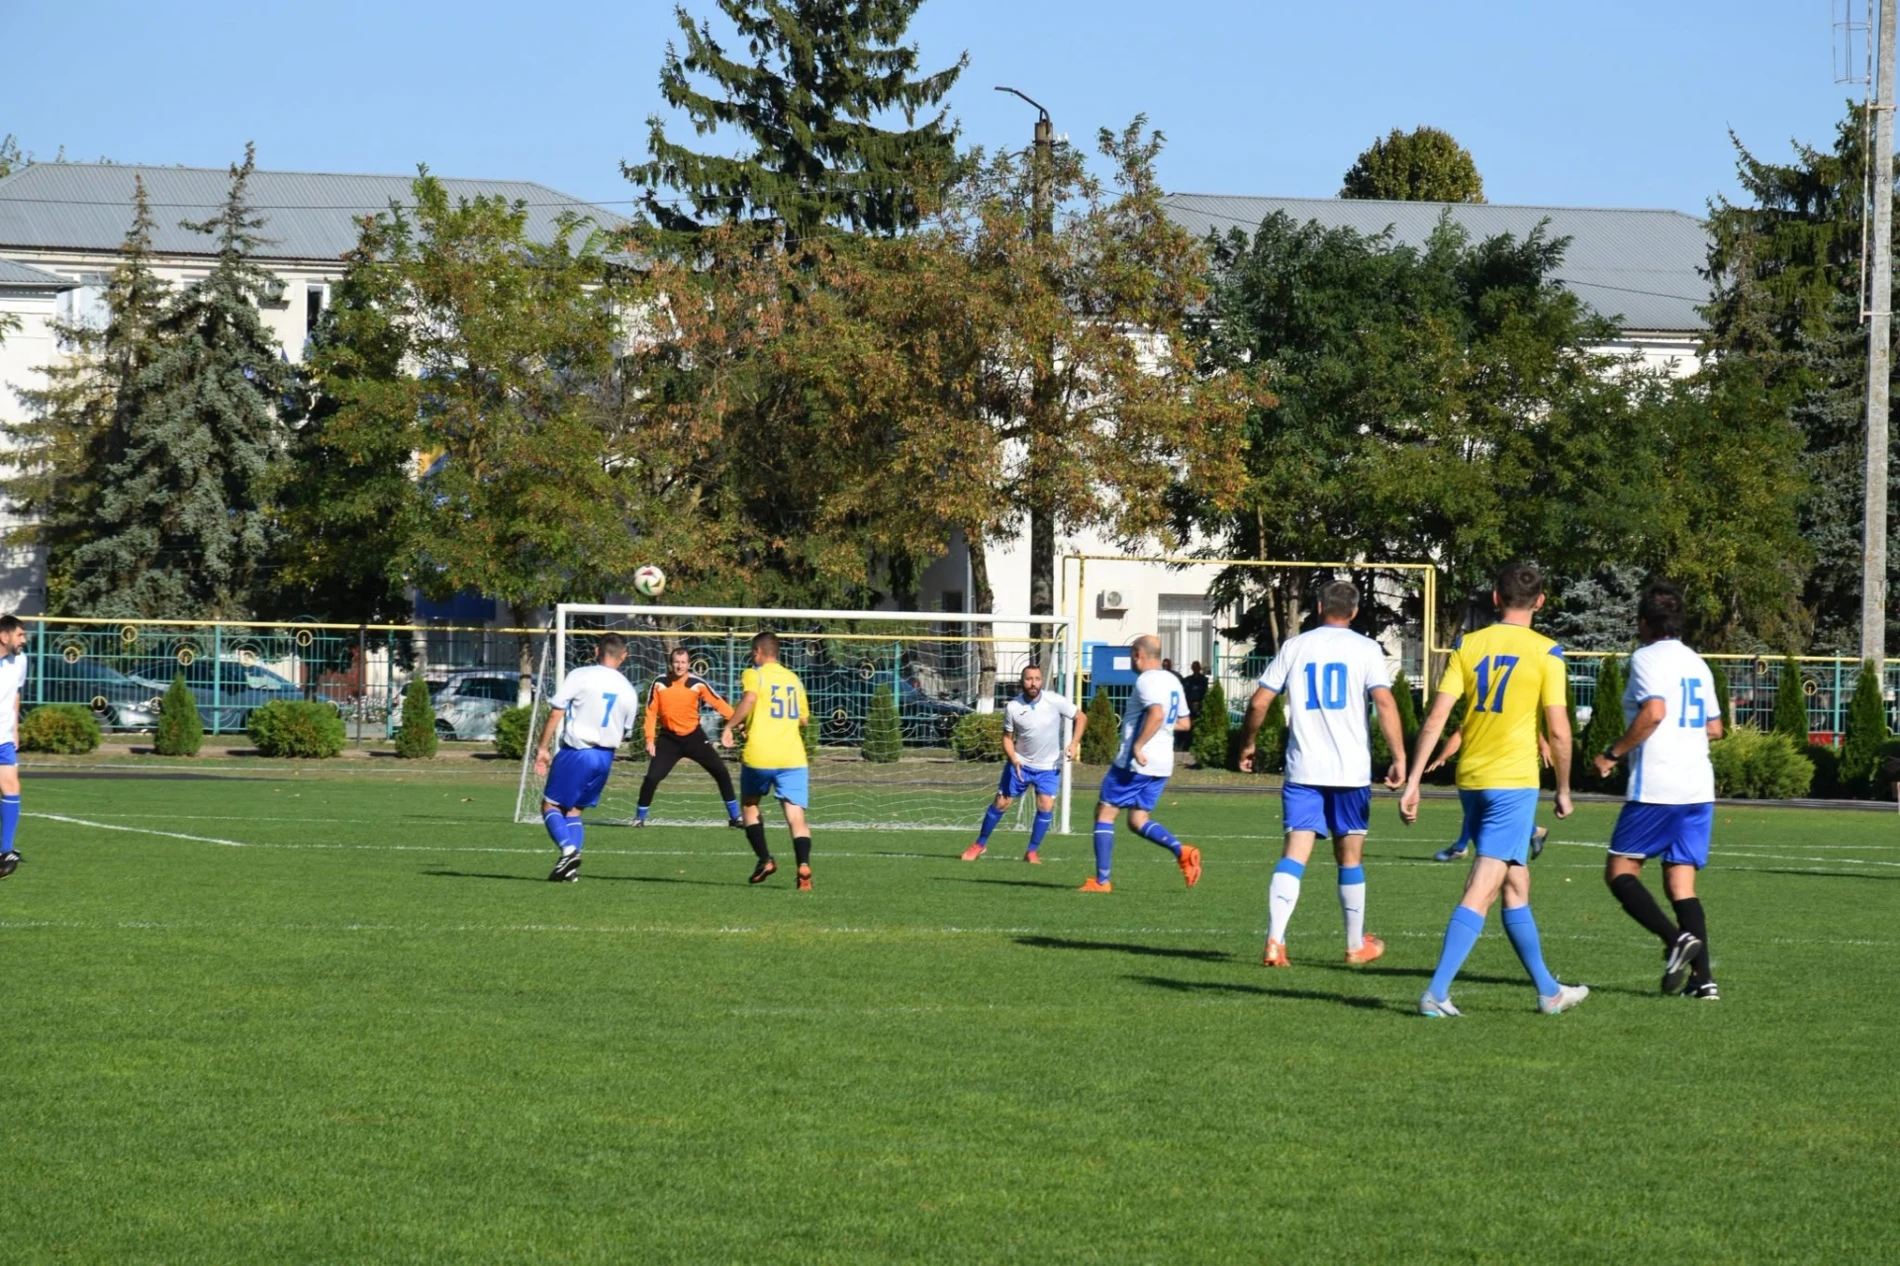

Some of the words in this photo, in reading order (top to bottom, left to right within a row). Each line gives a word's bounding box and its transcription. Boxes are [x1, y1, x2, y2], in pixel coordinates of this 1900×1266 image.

[770, 685, 799, 719] 50
[1304, 662, 1347, 710] 10
[1473, 655, 1520, 713] 17
[1679, 677, 1705, 728] 15
[601, 692, 618, 728] 7
[1167, 690, 1180, 724] 8
